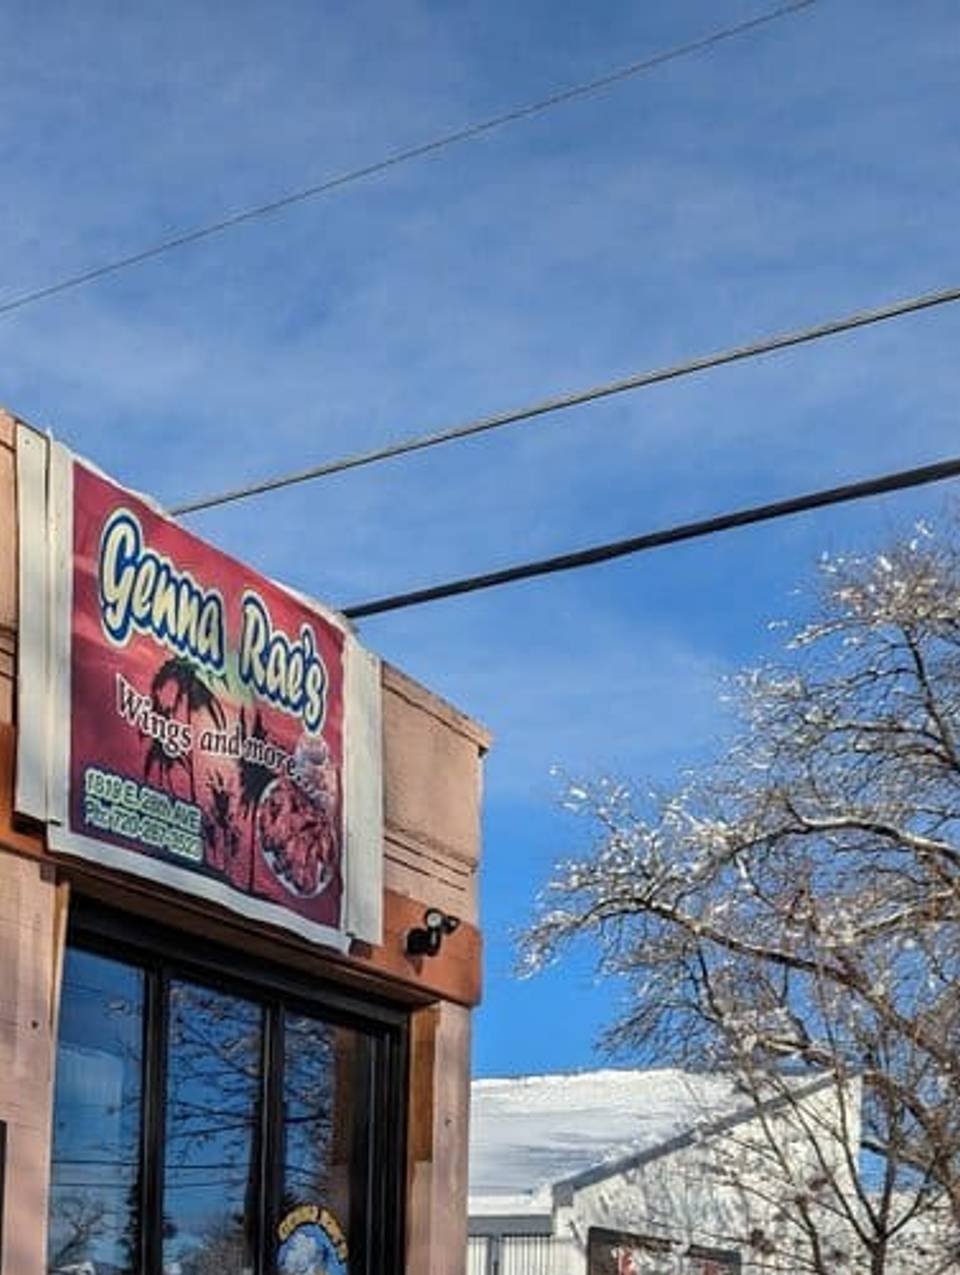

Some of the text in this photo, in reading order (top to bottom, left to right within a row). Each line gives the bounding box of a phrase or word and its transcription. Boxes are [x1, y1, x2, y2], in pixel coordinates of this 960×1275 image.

[99, 508, 326, 737] Genna Rae's
[116, 673, 192, 757] Wings
[200, 722, 242, 758] and
